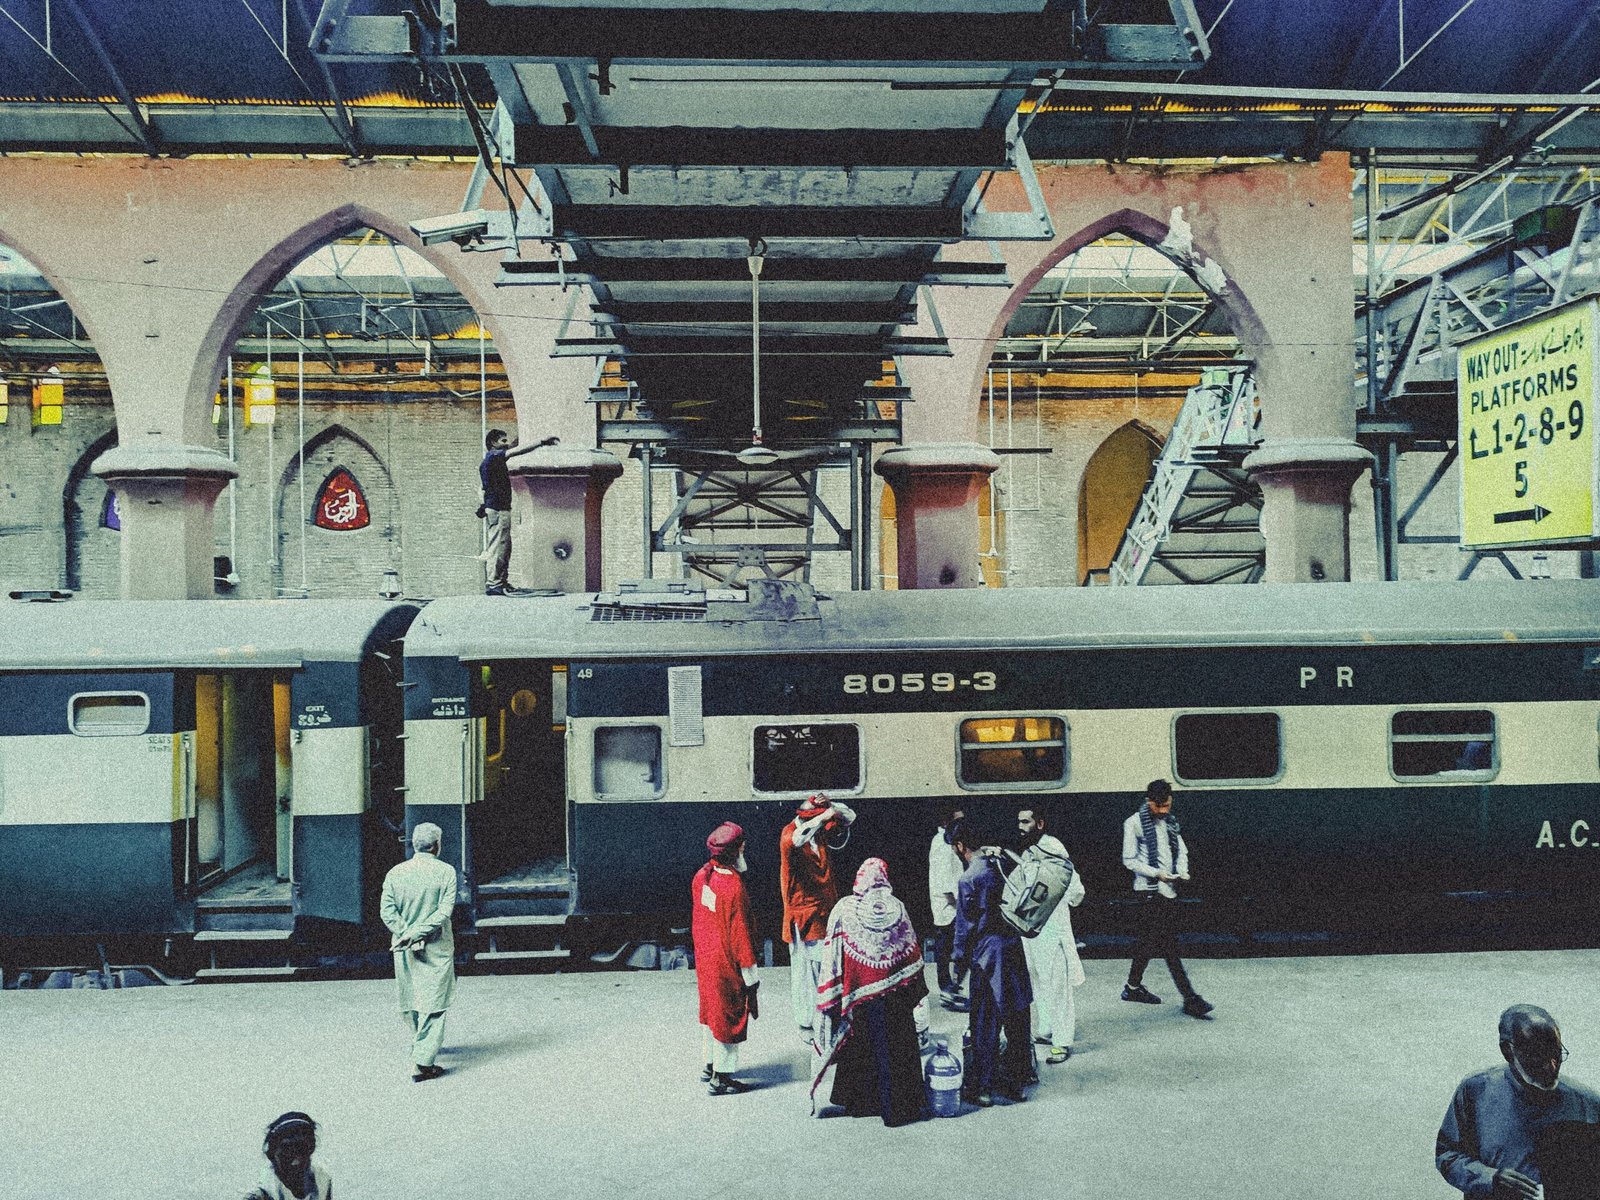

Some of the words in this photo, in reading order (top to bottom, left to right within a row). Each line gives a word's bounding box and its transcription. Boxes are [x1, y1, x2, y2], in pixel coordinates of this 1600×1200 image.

[1466, 350, 1490, 384] WAY
[1493, 342, 1519, 375] OUT
[1471, 363, 1578, 415] PLATFORMS
[1492, 400, 1584, 455] 1-2-8-9
[1514, 460, 1528, 498] 5
[843, 671, 997, 694] 8059-3
[1300, 666, 1317, 688] P
[1336, 666, 1354, 688] R
[1535, 819, 1600, 848] A.C.
